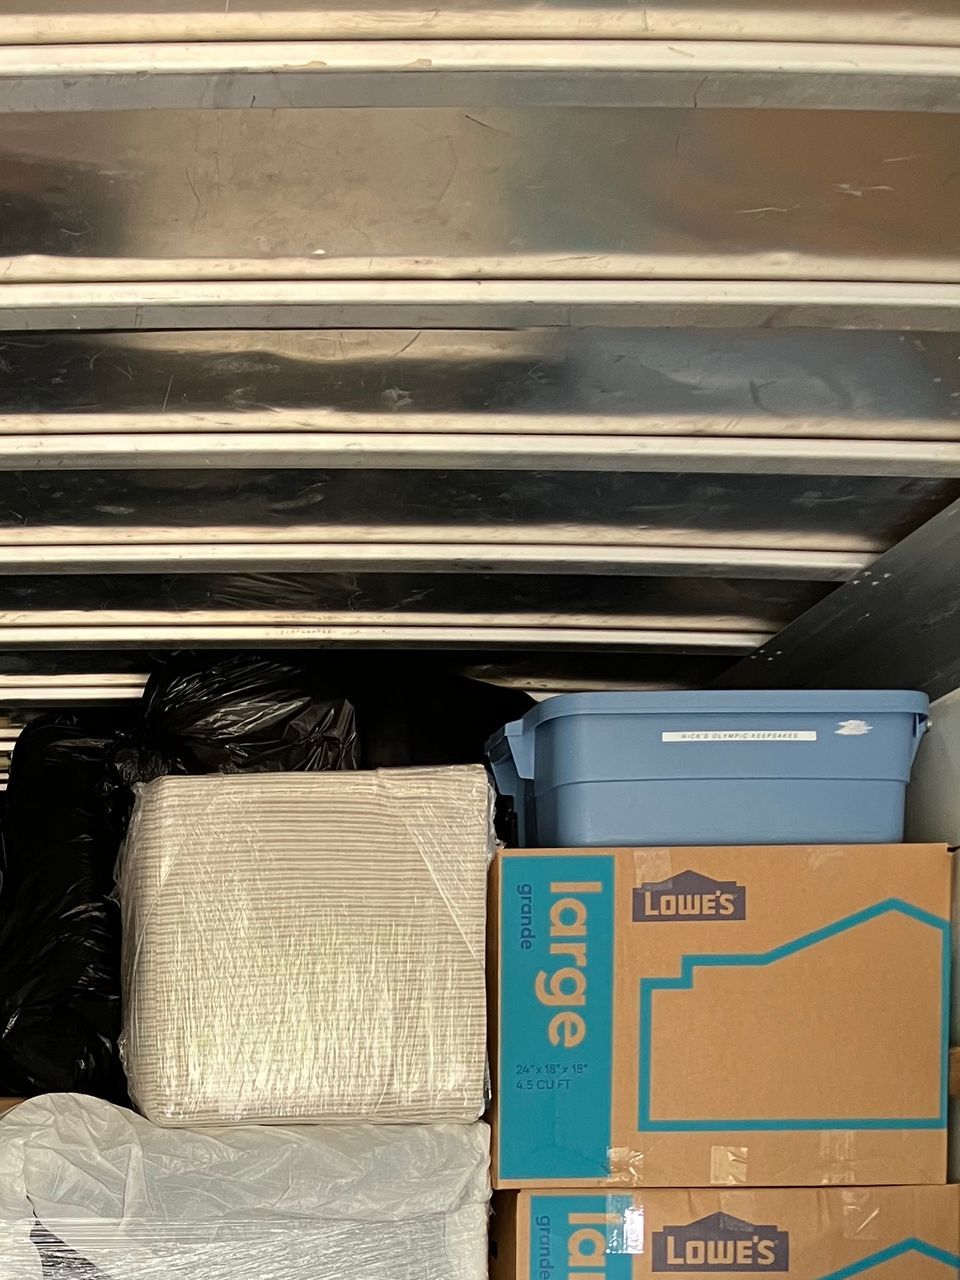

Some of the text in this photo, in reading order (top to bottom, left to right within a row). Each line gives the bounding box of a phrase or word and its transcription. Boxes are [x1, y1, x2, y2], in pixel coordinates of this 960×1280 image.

[712, 732, 748, 740] OLYMPIC
[517, 884, 536, 950] grande
[644, 890, 735, 915] LOWE'S
[534, 882, 602, 1048] large
[516, 1079, 572, 1090] 4.5 CU FT
[535, 1215, 555, 1280] grande
[666, 1235, 776, 1265] LOWE'S
